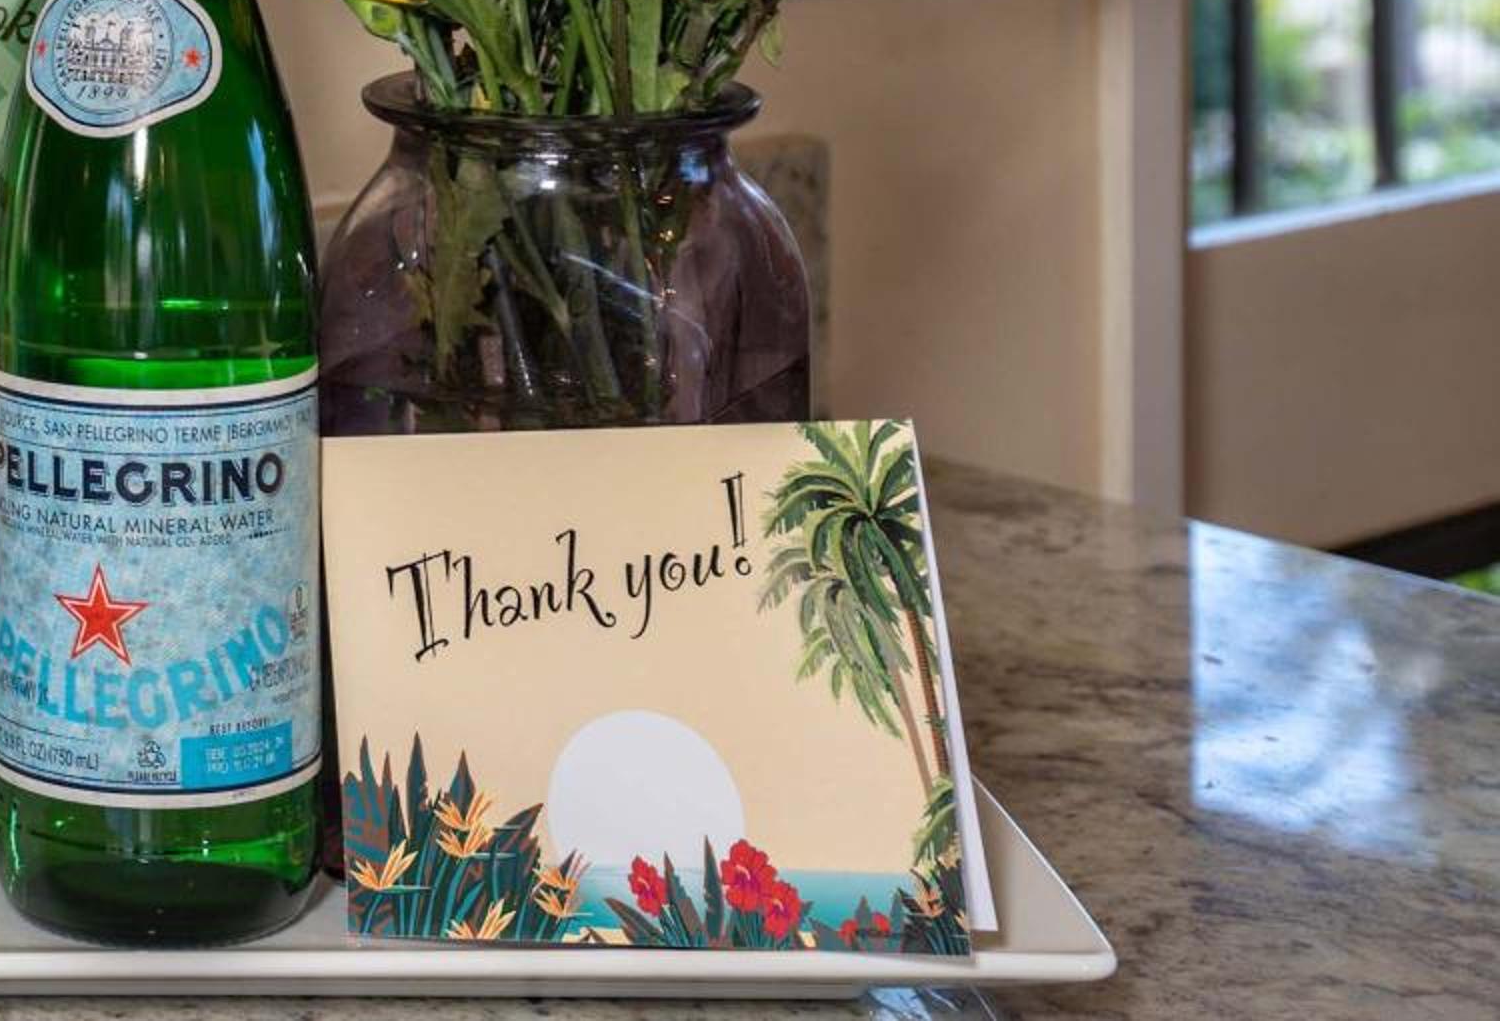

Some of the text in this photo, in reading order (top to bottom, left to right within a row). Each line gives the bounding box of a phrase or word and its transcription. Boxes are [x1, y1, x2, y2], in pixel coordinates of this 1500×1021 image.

[43, 418, 72, 437] SAN
[77, 423, 168, 444] PELLEGRINO
[174, 424, 222, 443] TERME
[37, 508, 117, 534] NATURAL
[125, 515, 213, 536] MINERAL
[219, 508, 275, 531] WATER
[385, 470, 754, 663] Thank you!
